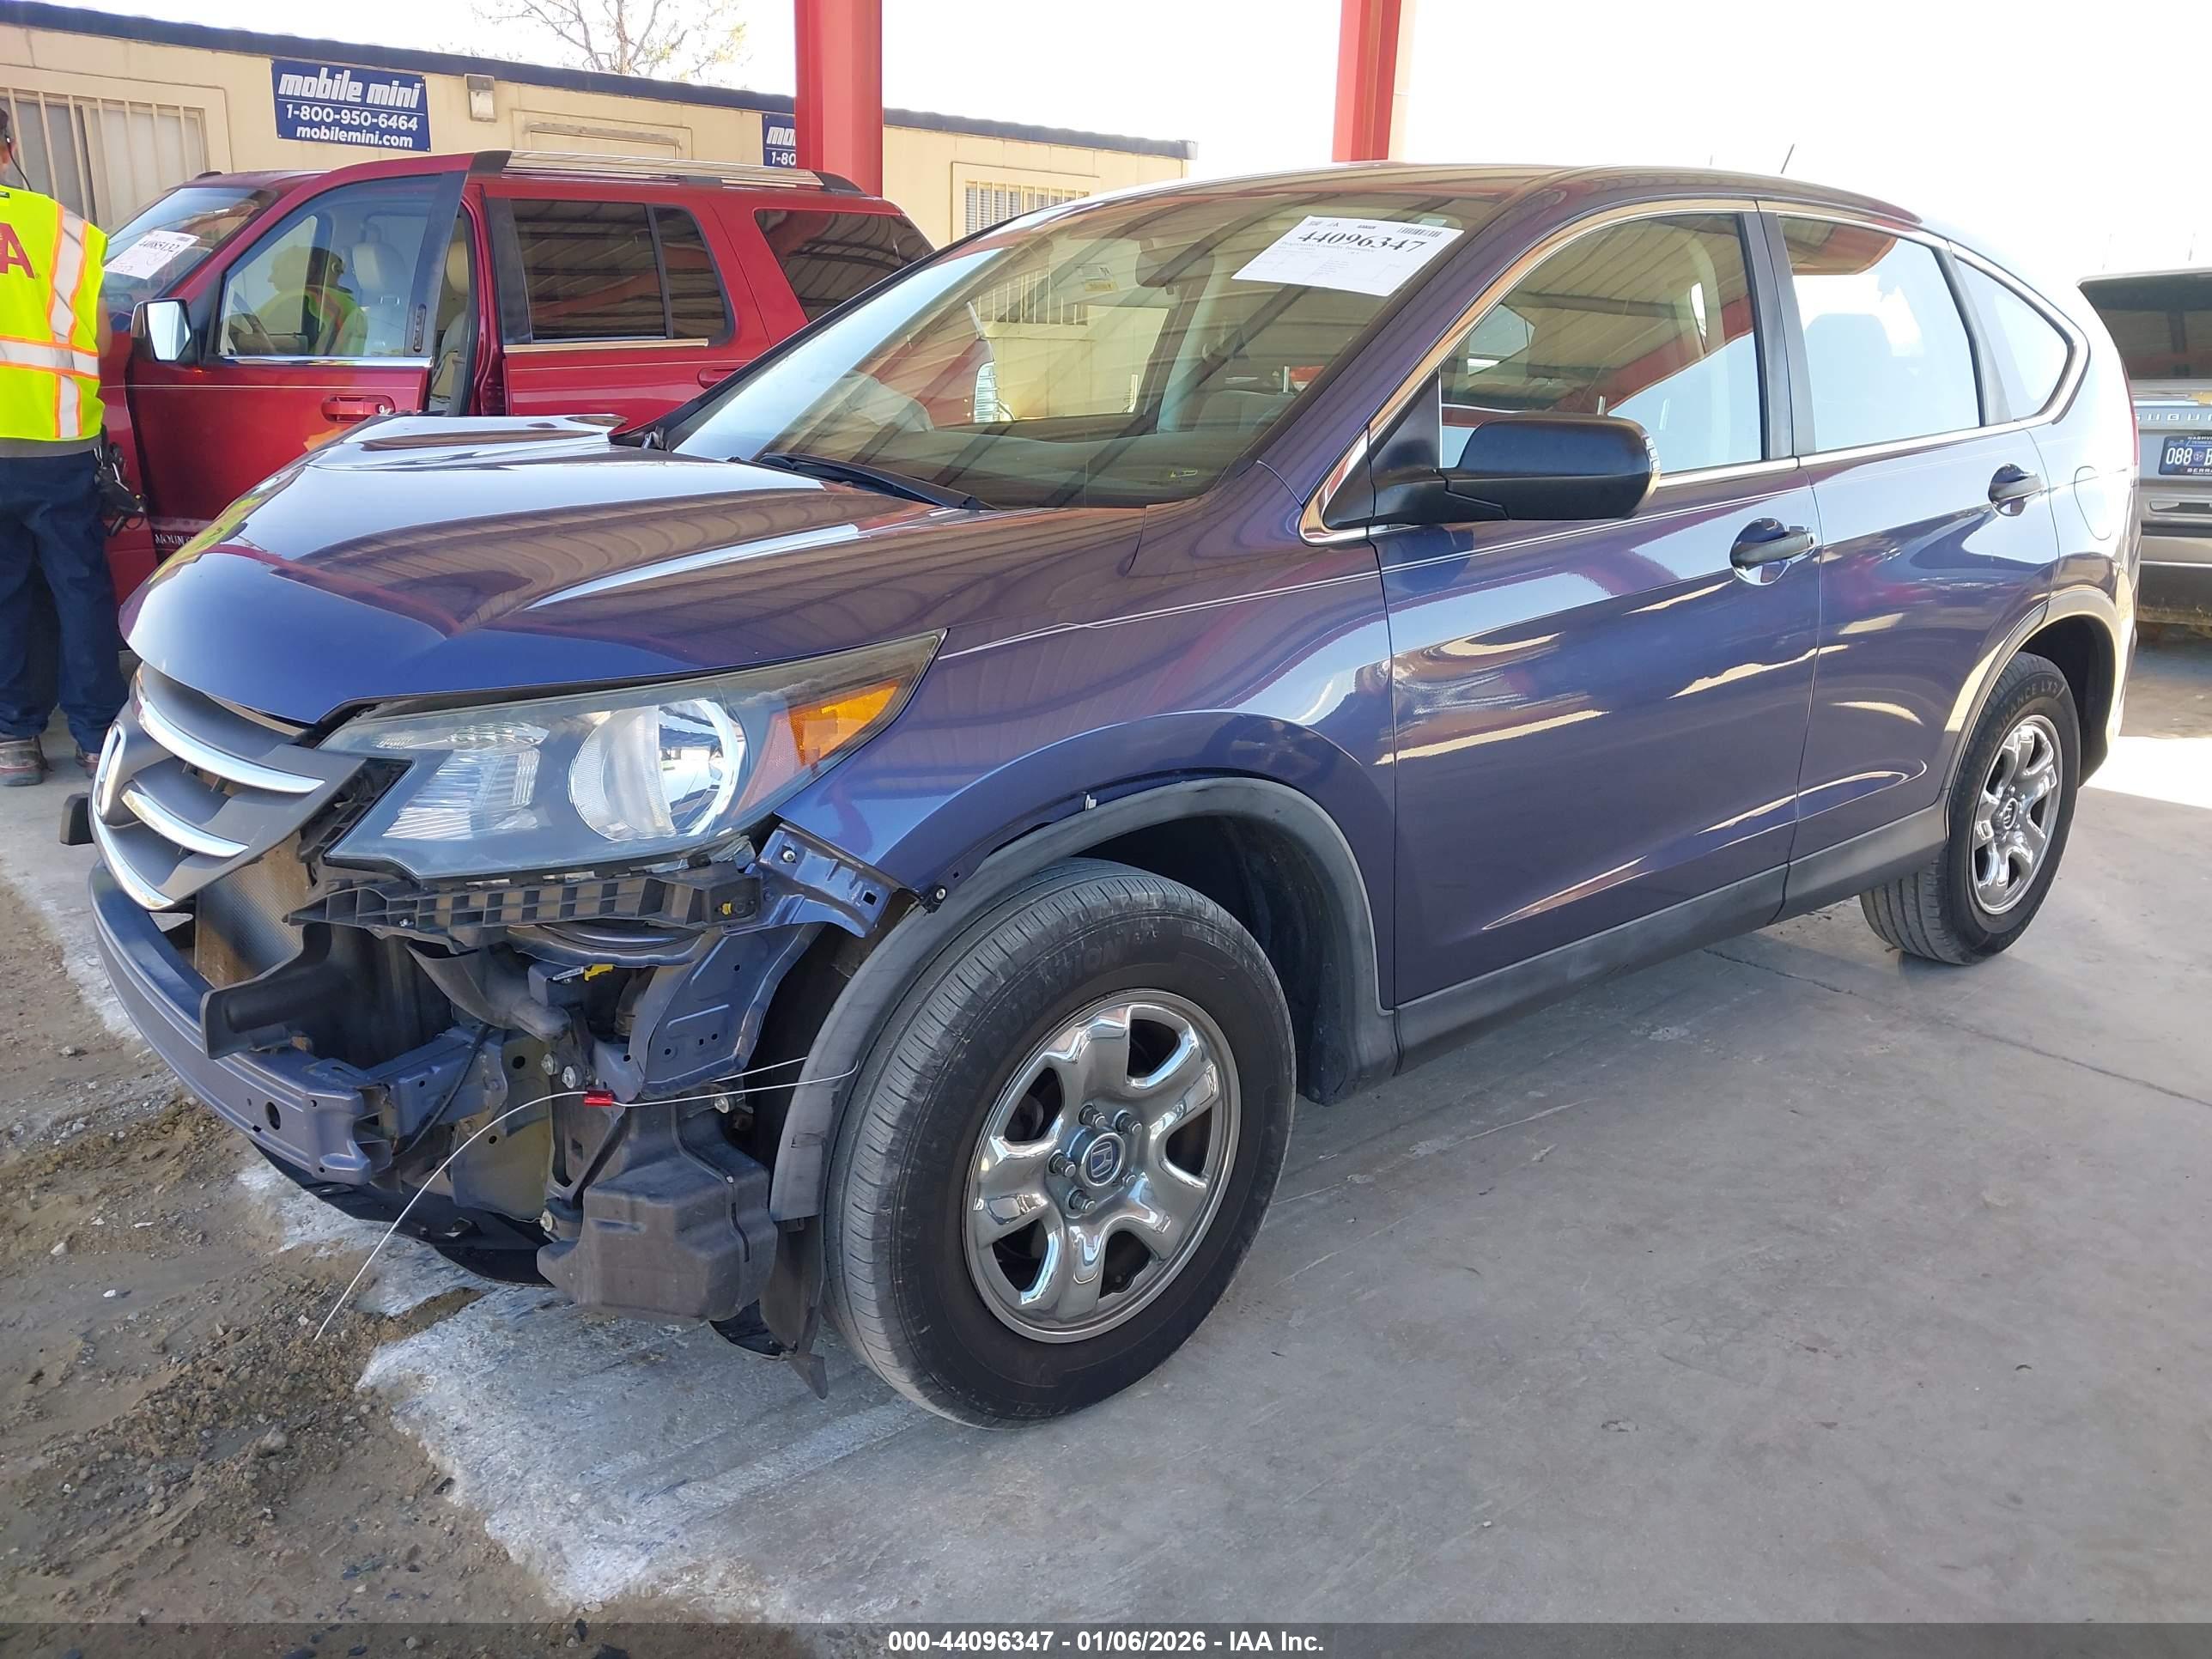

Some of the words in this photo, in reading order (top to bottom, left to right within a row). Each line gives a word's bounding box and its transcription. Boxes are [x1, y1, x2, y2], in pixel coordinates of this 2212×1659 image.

[278, 67, 362, 103] mobile
[366, 80, 421, 108] mini
[286, 104, 418, 131] 1-800-950-6464
[296, 125, 413, 149] mobilemini.com
[766, 126, 796, 146] mo
[1297, 230, 1427, 253] 44096347
[2166, 447, 2193, 465] 088
